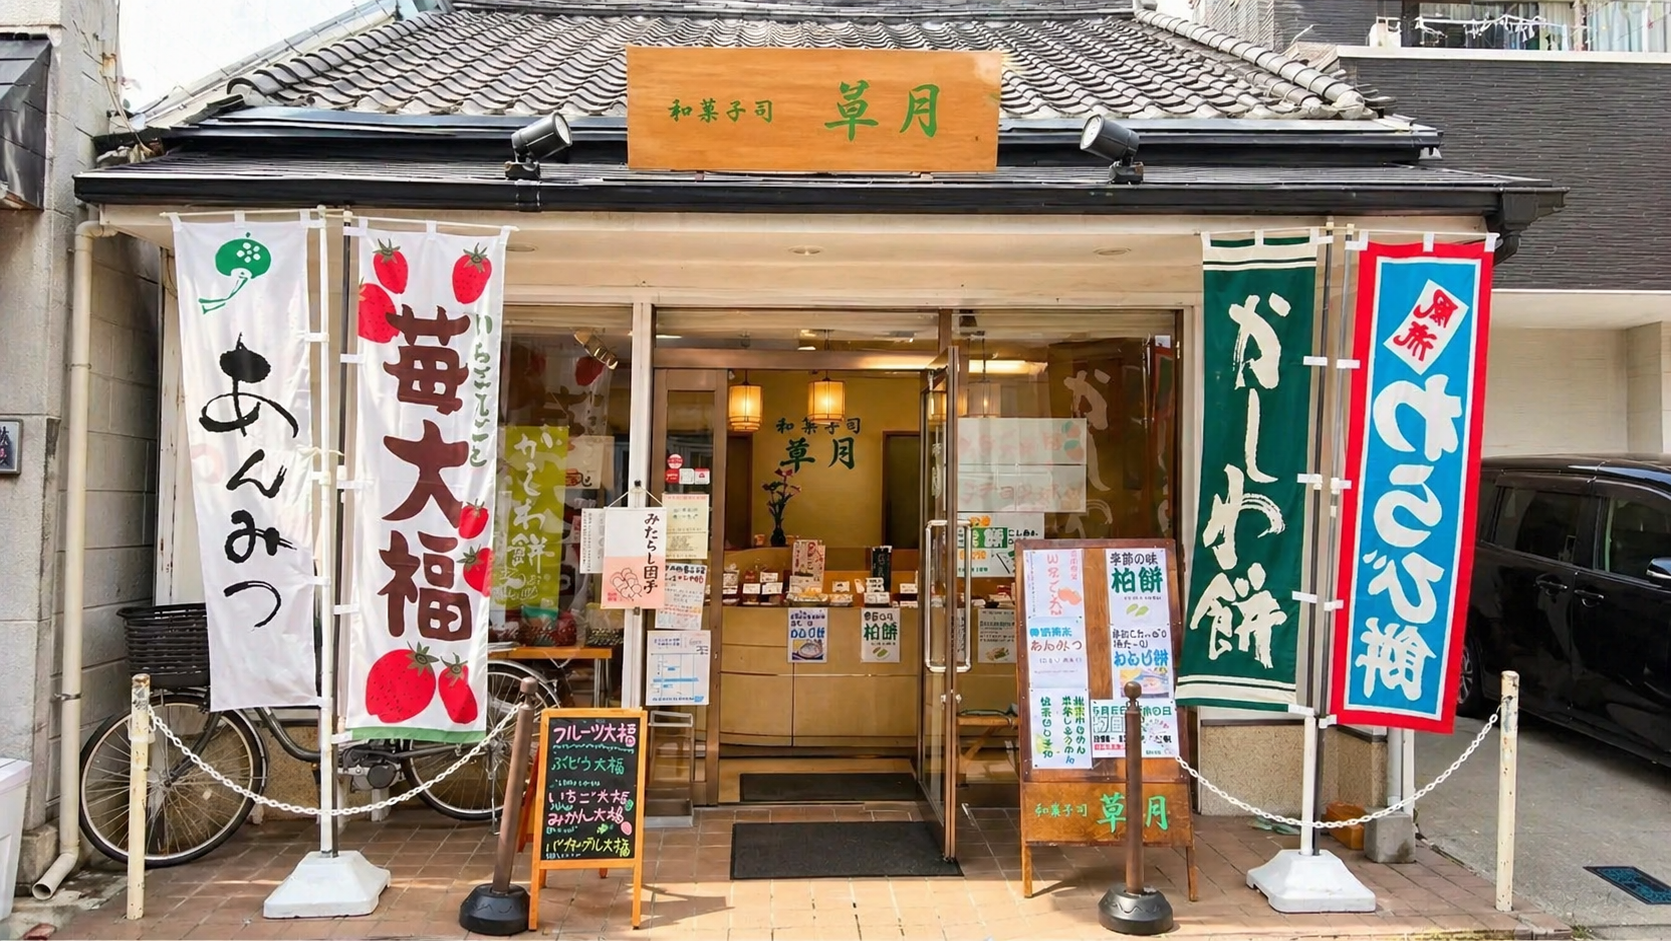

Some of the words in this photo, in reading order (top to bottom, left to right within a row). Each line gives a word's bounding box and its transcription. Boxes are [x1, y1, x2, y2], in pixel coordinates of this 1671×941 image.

[668, 98, 774, 124] 和菓子司
[824, 80, 940, 141] 草月
[776, 416, 861, 435] 和菓子司
[779, 437, 855, 474] 草月
[198, 331, 299, 631] あんみつ
[377, 303, 473, 641] 苺大福
[1190, 292, 1292, 669] かしわ餅
[1110, 552, 1159, 566] 季節の味
[1111, 566, 1163, 593] 柏餅
[863, 621, 898, 641] 柏餅
[553, 723, 637, 748] フルーツ大福
[551, 756, 624, 775] ぶどう大福
[1034, 803, 1088, 818] 和菓子司
[1095, 791, 1169, 834] 草月
